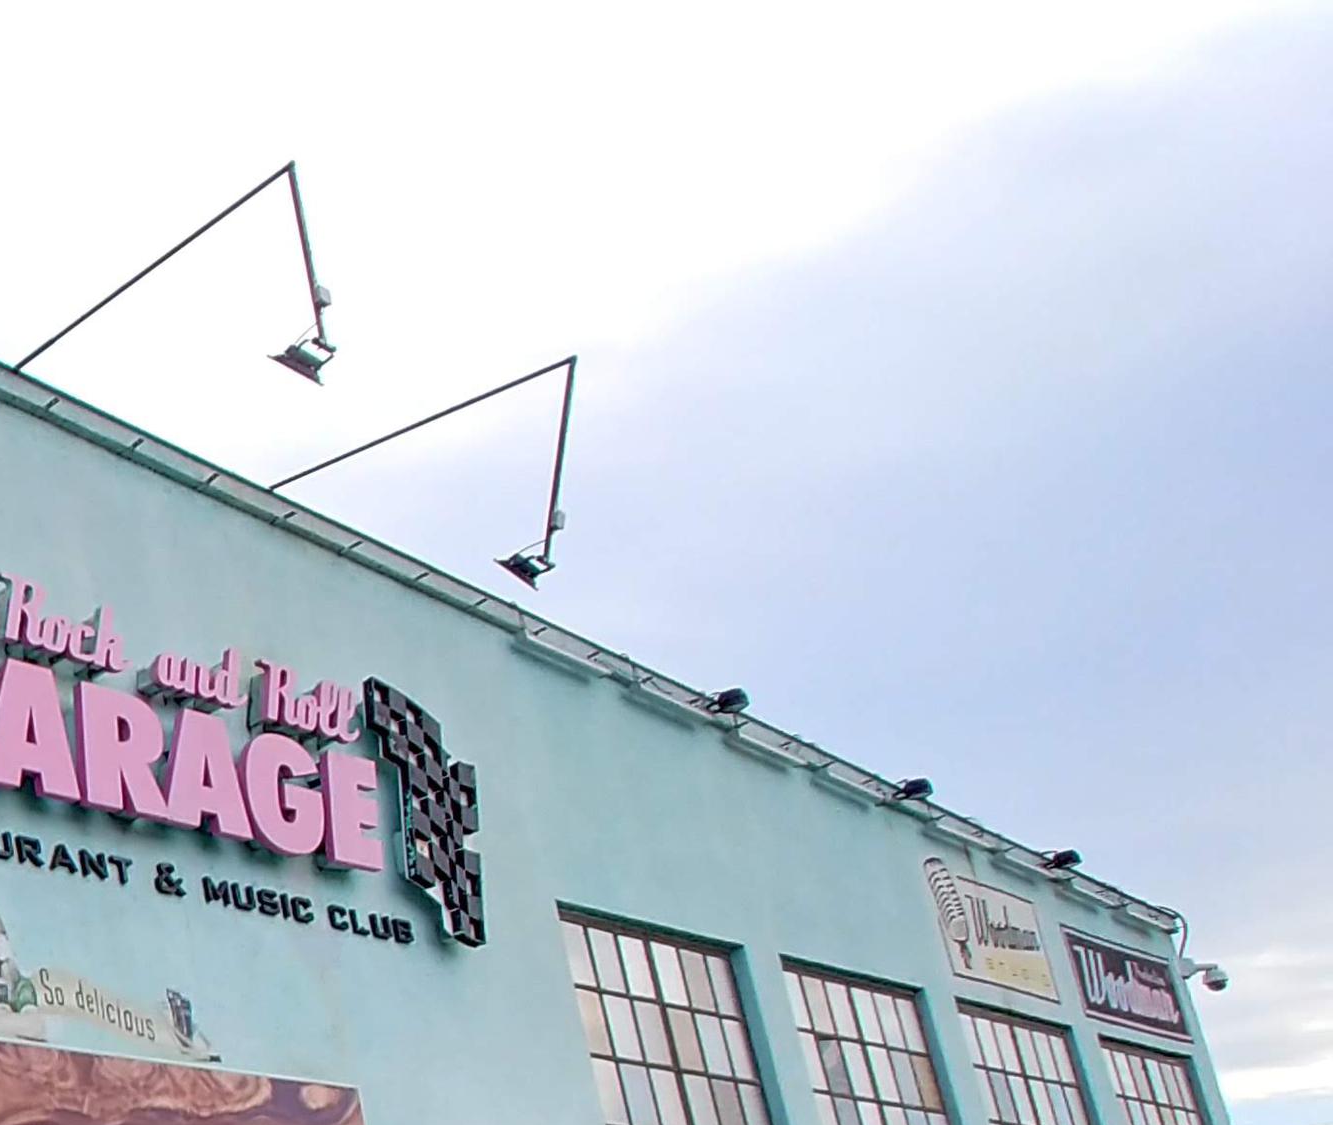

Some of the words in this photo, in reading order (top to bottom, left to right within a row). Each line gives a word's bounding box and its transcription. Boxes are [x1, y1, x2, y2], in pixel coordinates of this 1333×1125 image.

[151, 647, 247, 708] and
[255, 659, 360, 743] Roll
[154, 862, 185, 897] &
[202, 876, 314, 925] MUSIC
[326, 904, 415, 944] CLUB
[39, 968, 65, 1006] So
[75, 980, 156, 1041] delicious
